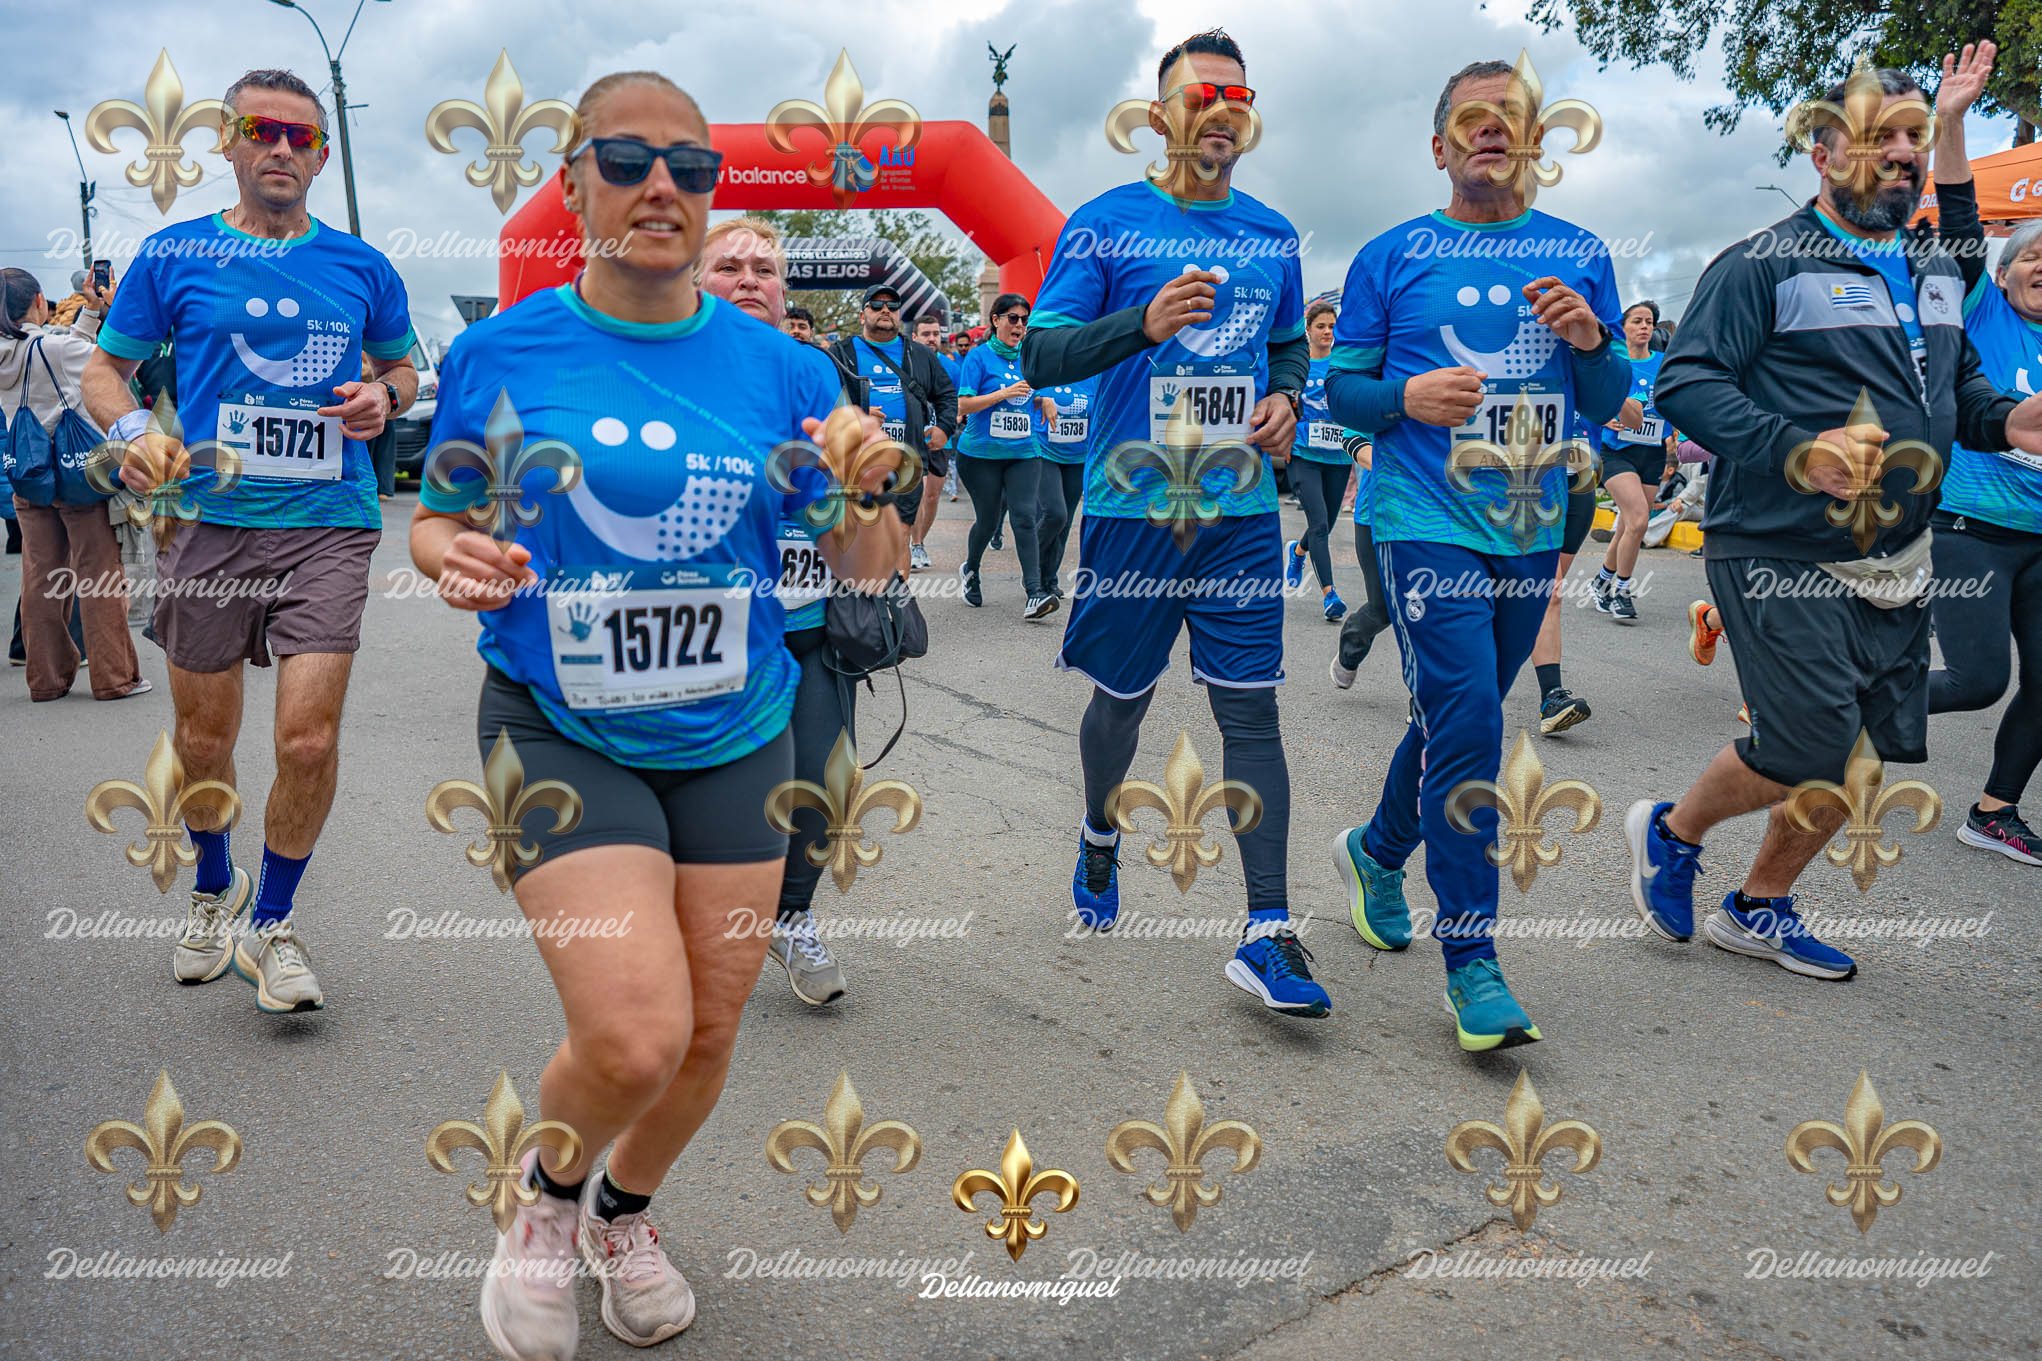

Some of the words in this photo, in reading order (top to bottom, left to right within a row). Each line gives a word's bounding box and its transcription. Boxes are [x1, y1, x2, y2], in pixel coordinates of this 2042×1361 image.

[879, 144, 915, 167] AAU
[728, 166, 808, 185] balance
[816, 264, 871, 278] LEJOS
[1183, 386, 1247, 426] 15847
[1002, 415, 1029, 432] 15830
[1059, 421, 1084, 436] 15738
[1486, 403, 1557, 446] 15848
[251, 416, 326, 460] 15721
[603, 603, 724, 675] 15722
